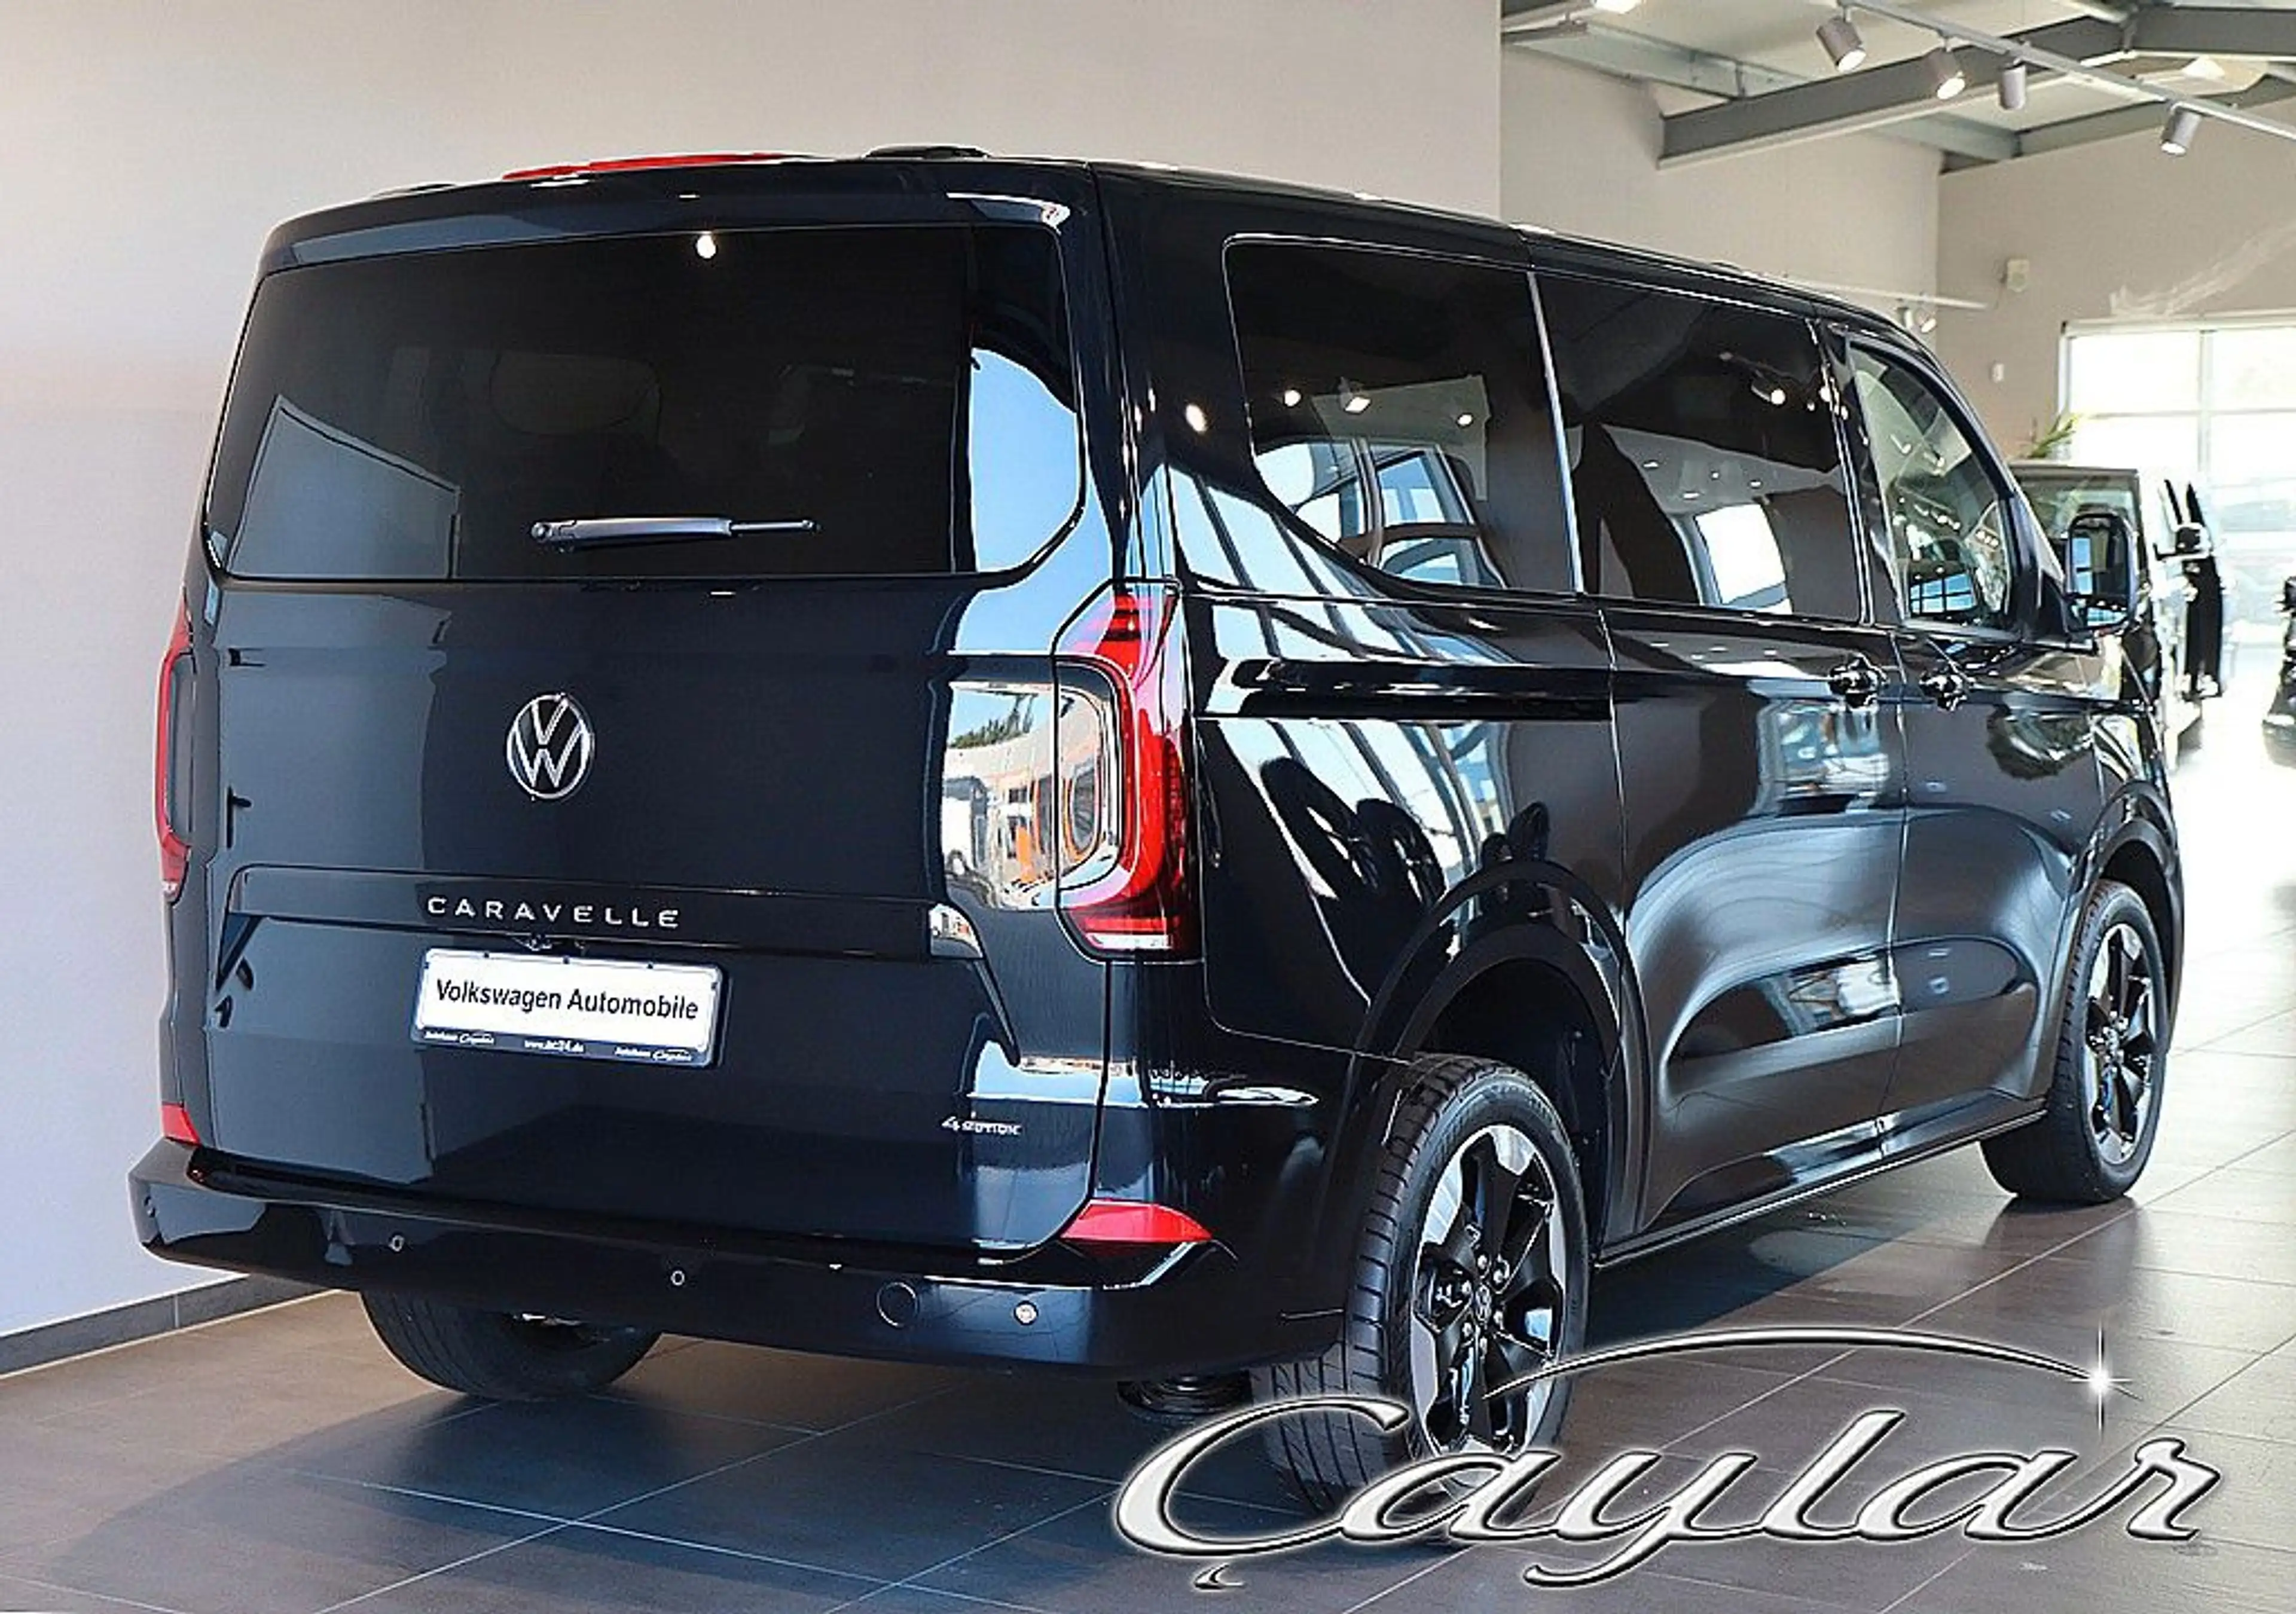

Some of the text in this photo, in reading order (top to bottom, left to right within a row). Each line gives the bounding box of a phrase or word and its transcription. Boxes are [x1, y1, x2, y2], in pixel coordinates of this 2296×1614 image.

[511, 696, 588, 793] VW
[427, 897, 679, 928] CARAVELLE
[436, 978, 698, 1020] Volkswagen Automobile
